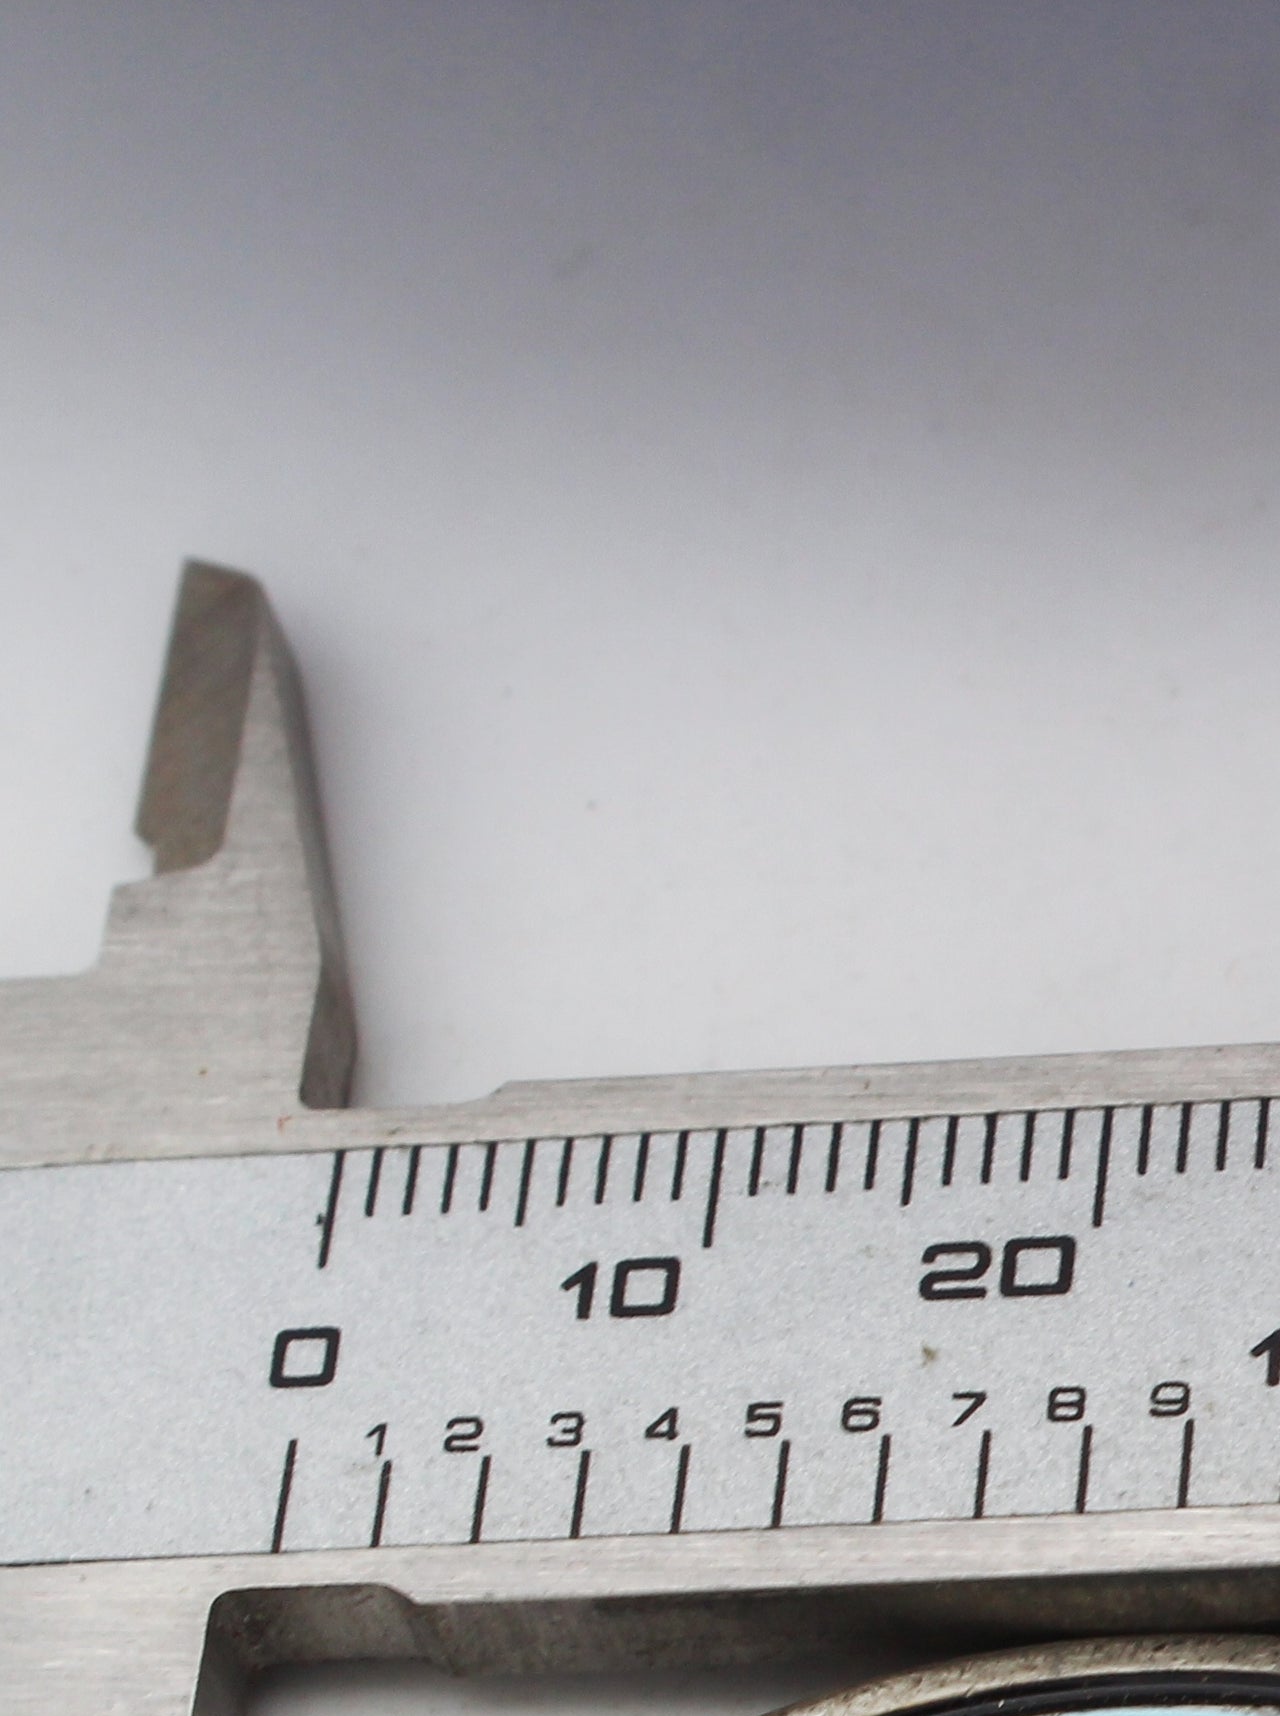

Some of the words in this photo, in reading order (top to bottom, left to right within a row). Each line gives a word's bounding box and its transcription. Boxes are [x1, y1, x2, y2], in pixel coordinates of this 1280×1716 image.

[269, 1326, 342, 1389] 0
[560, 1256, 681, 1320] 10
[918, 1235, 1077, 1302] 20
[366, 1422, 388, 1457] 1
[443, 1416, 484, 1453] 2
[546, 1412, 585, 1448] 3
[643, 1406, 680, 1441] 4
[744, 1401, 783, 1439] 5
[841, 1396, 882, 1433] 6
[951, 1391, 987, 1428] 7
[1047, 1386, 1087, 1423] 8
[1149, 1381, 1191, 1418] 9
